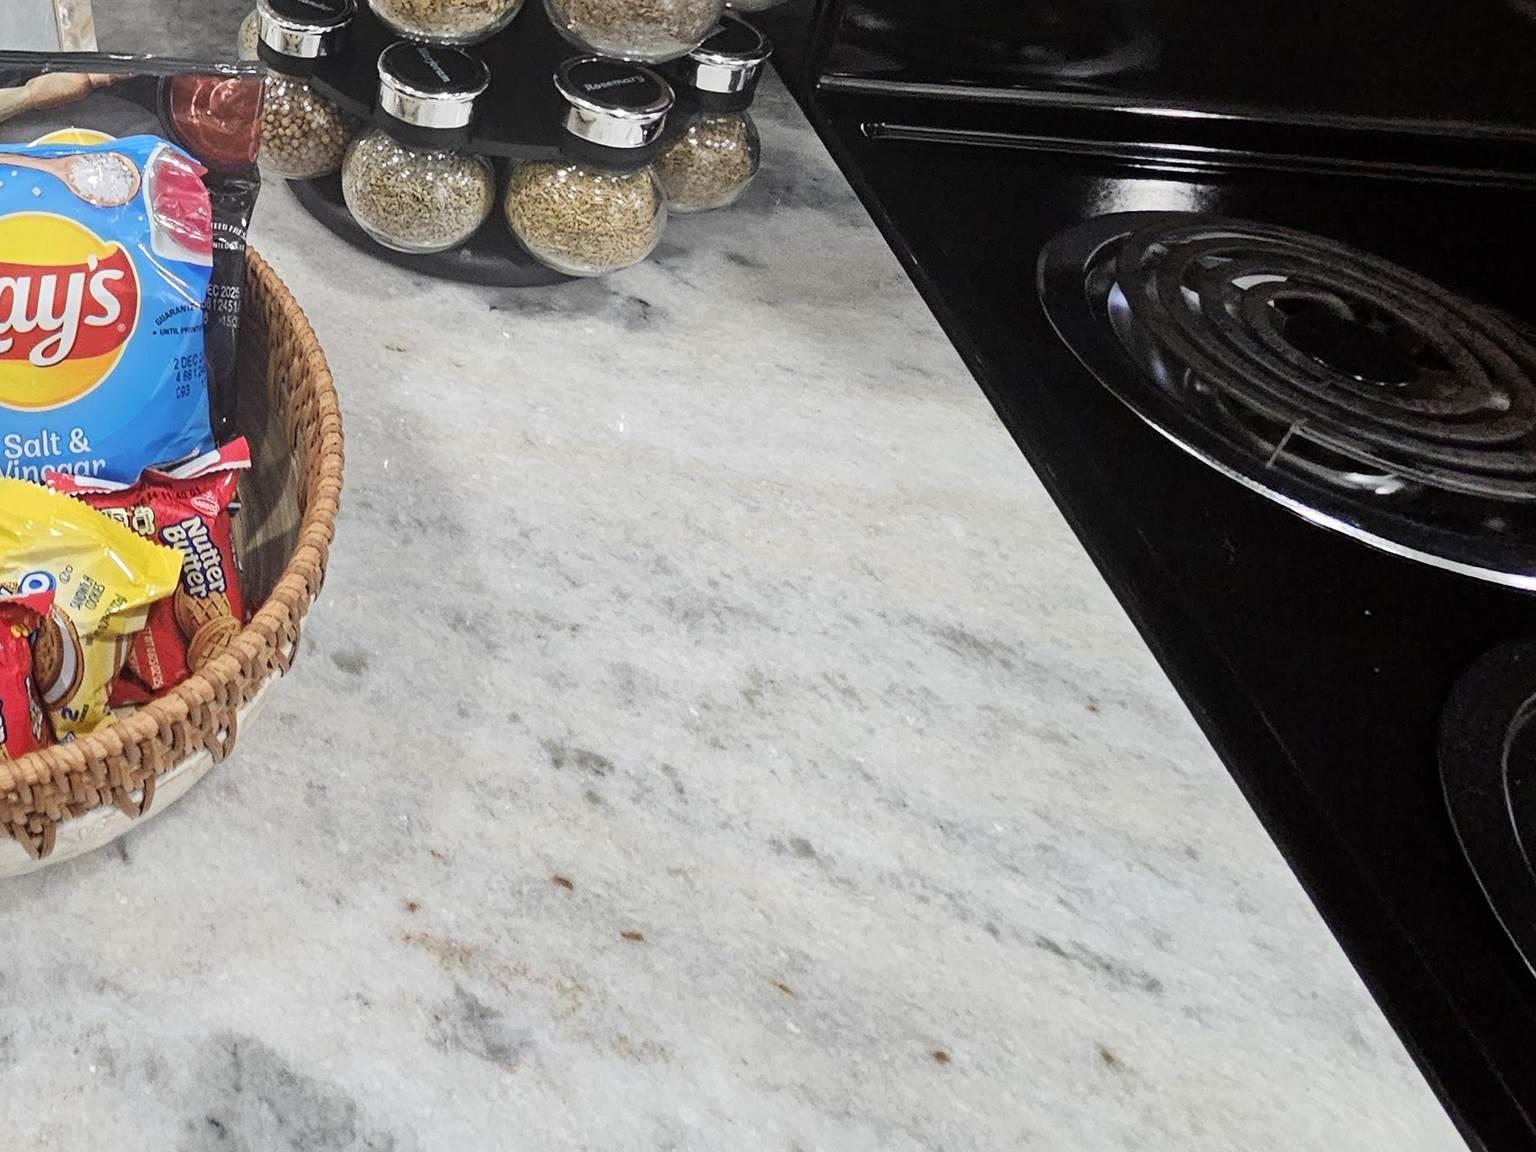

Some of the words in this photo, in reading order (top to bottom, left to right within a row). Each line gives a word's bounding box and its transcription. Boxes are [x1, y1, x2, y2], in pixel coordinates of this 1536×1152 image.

[584, 74, 646, 92] Rosemary
[4, 432, 61, 459] Salt
[69, 428, 91, 454] &
[181, 515, 225, 594] Nutter
